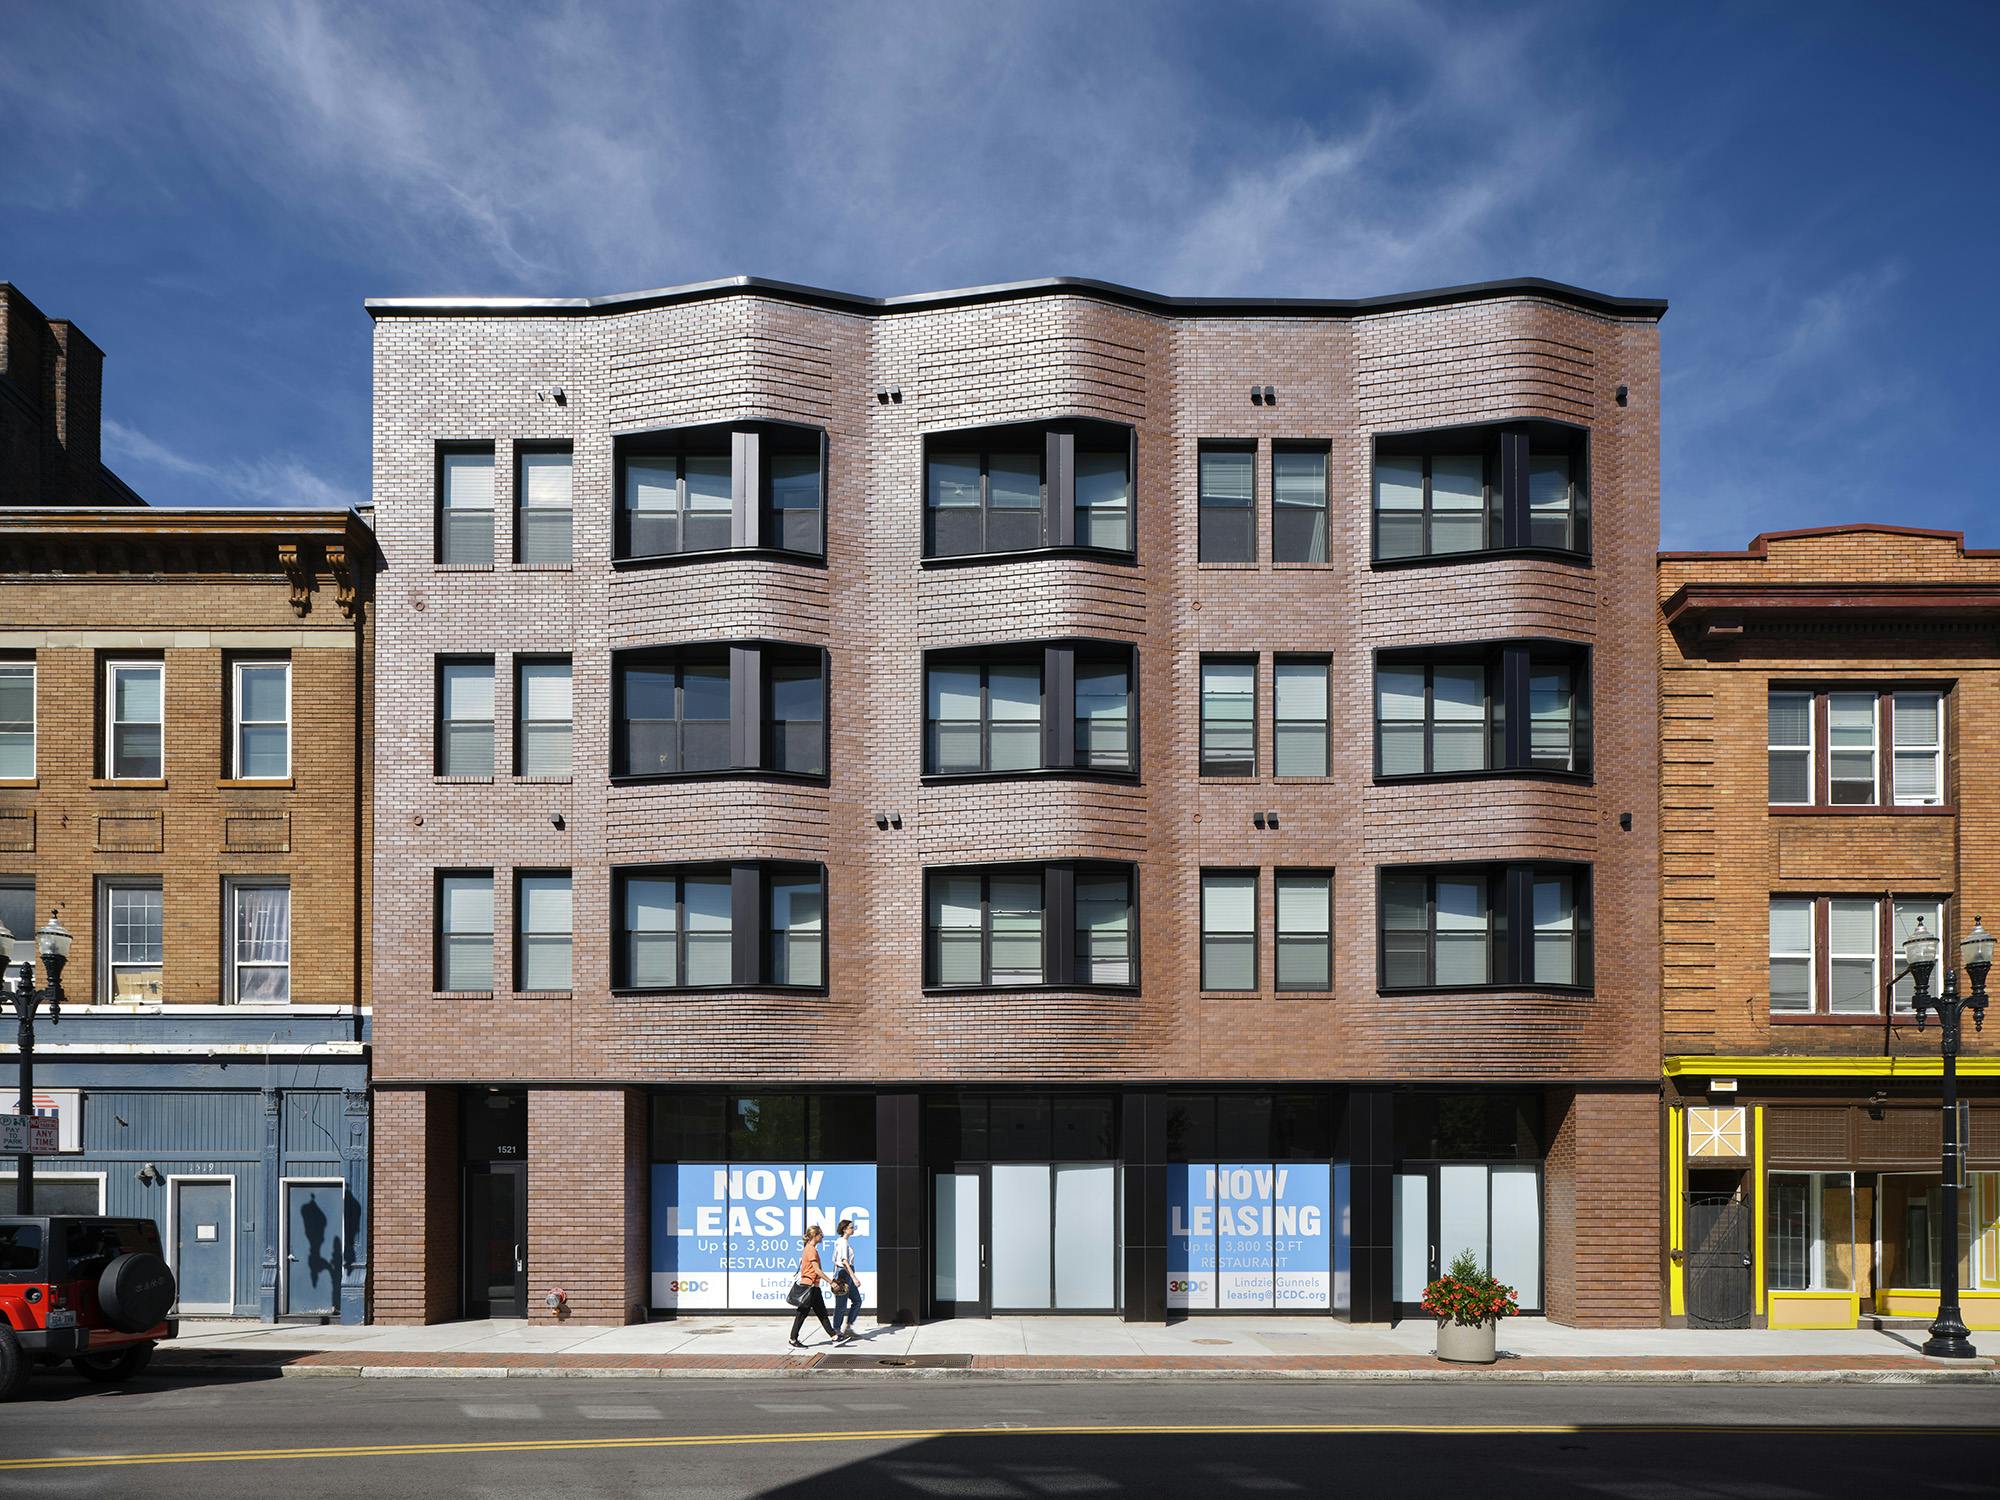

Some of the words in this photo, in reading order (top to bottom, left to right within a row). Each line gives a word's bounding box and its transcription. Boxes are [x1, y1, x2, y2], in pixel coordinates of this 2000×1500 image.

[497, 1145, 516, 1153] 1521
[713, 1169, 824, 1200] NOW
[1205, 1169, 1289, 1200] NOW
[666, 1205, 870, 1237] LEASING
[1172, 1205, 1321, 1237] LEASING
[698, 1239, 718, 1254] Up
[723, 1240, 738, 1251] to
[746, 1239, 789, 1253] 3,800
[1183, 1240, 1200, 1253] Up
[1204, 1240, 1216, 1251] to
[1225, 1240, 1261, 1252] 3,800
[1265, 1240, 1285, 1252] SQ
[1288, 1240, 1304, 1251] FT
[719, 1257, 803, 1269] RESTAURA
[1201, 1257, 1289, 1268] RESTAURANT
[670, 1280, 709, 1292] 3CDC
[760, 1278, 792, 1288] Lindz
[1169, 1280, 1208, 1292] 3CDC
[1235, 1276, 1273, 1288] Lindzie
[1276, 1276, 1320, 1288] Gunnels
